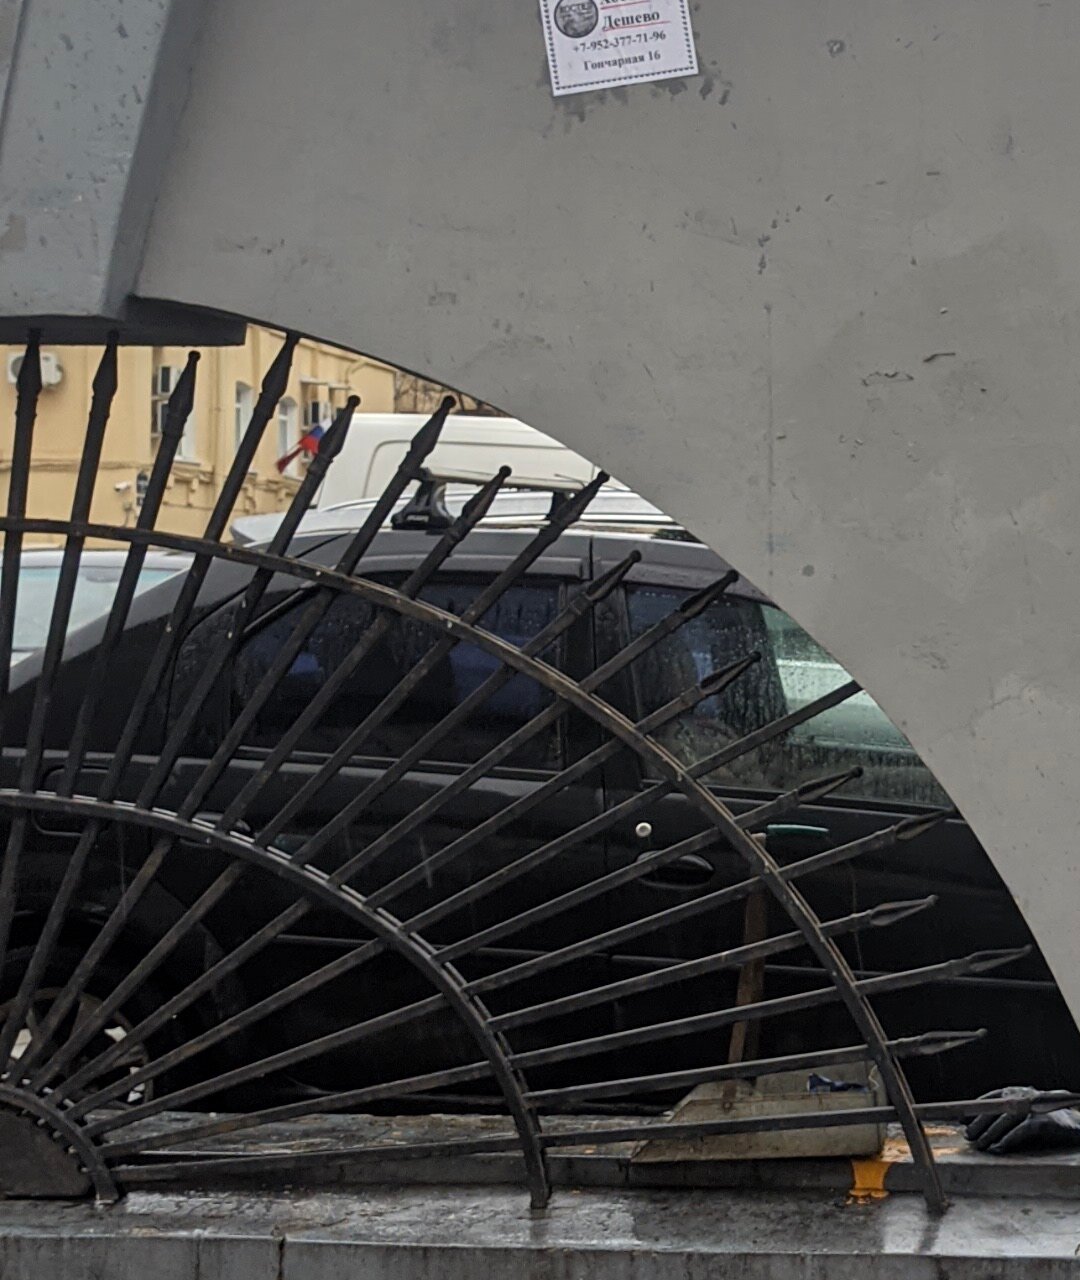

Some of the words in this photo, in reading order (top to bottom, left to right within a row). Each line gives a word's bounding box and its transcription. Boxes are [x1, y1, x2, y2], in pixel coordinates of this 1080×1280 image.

[602, 11, 660, 32] Дешево
[573, 31, 667, 53] +7-952-377-71-96
[583, 54, 645, 71] Гончарная
[648, 50, 661, 62] 16
